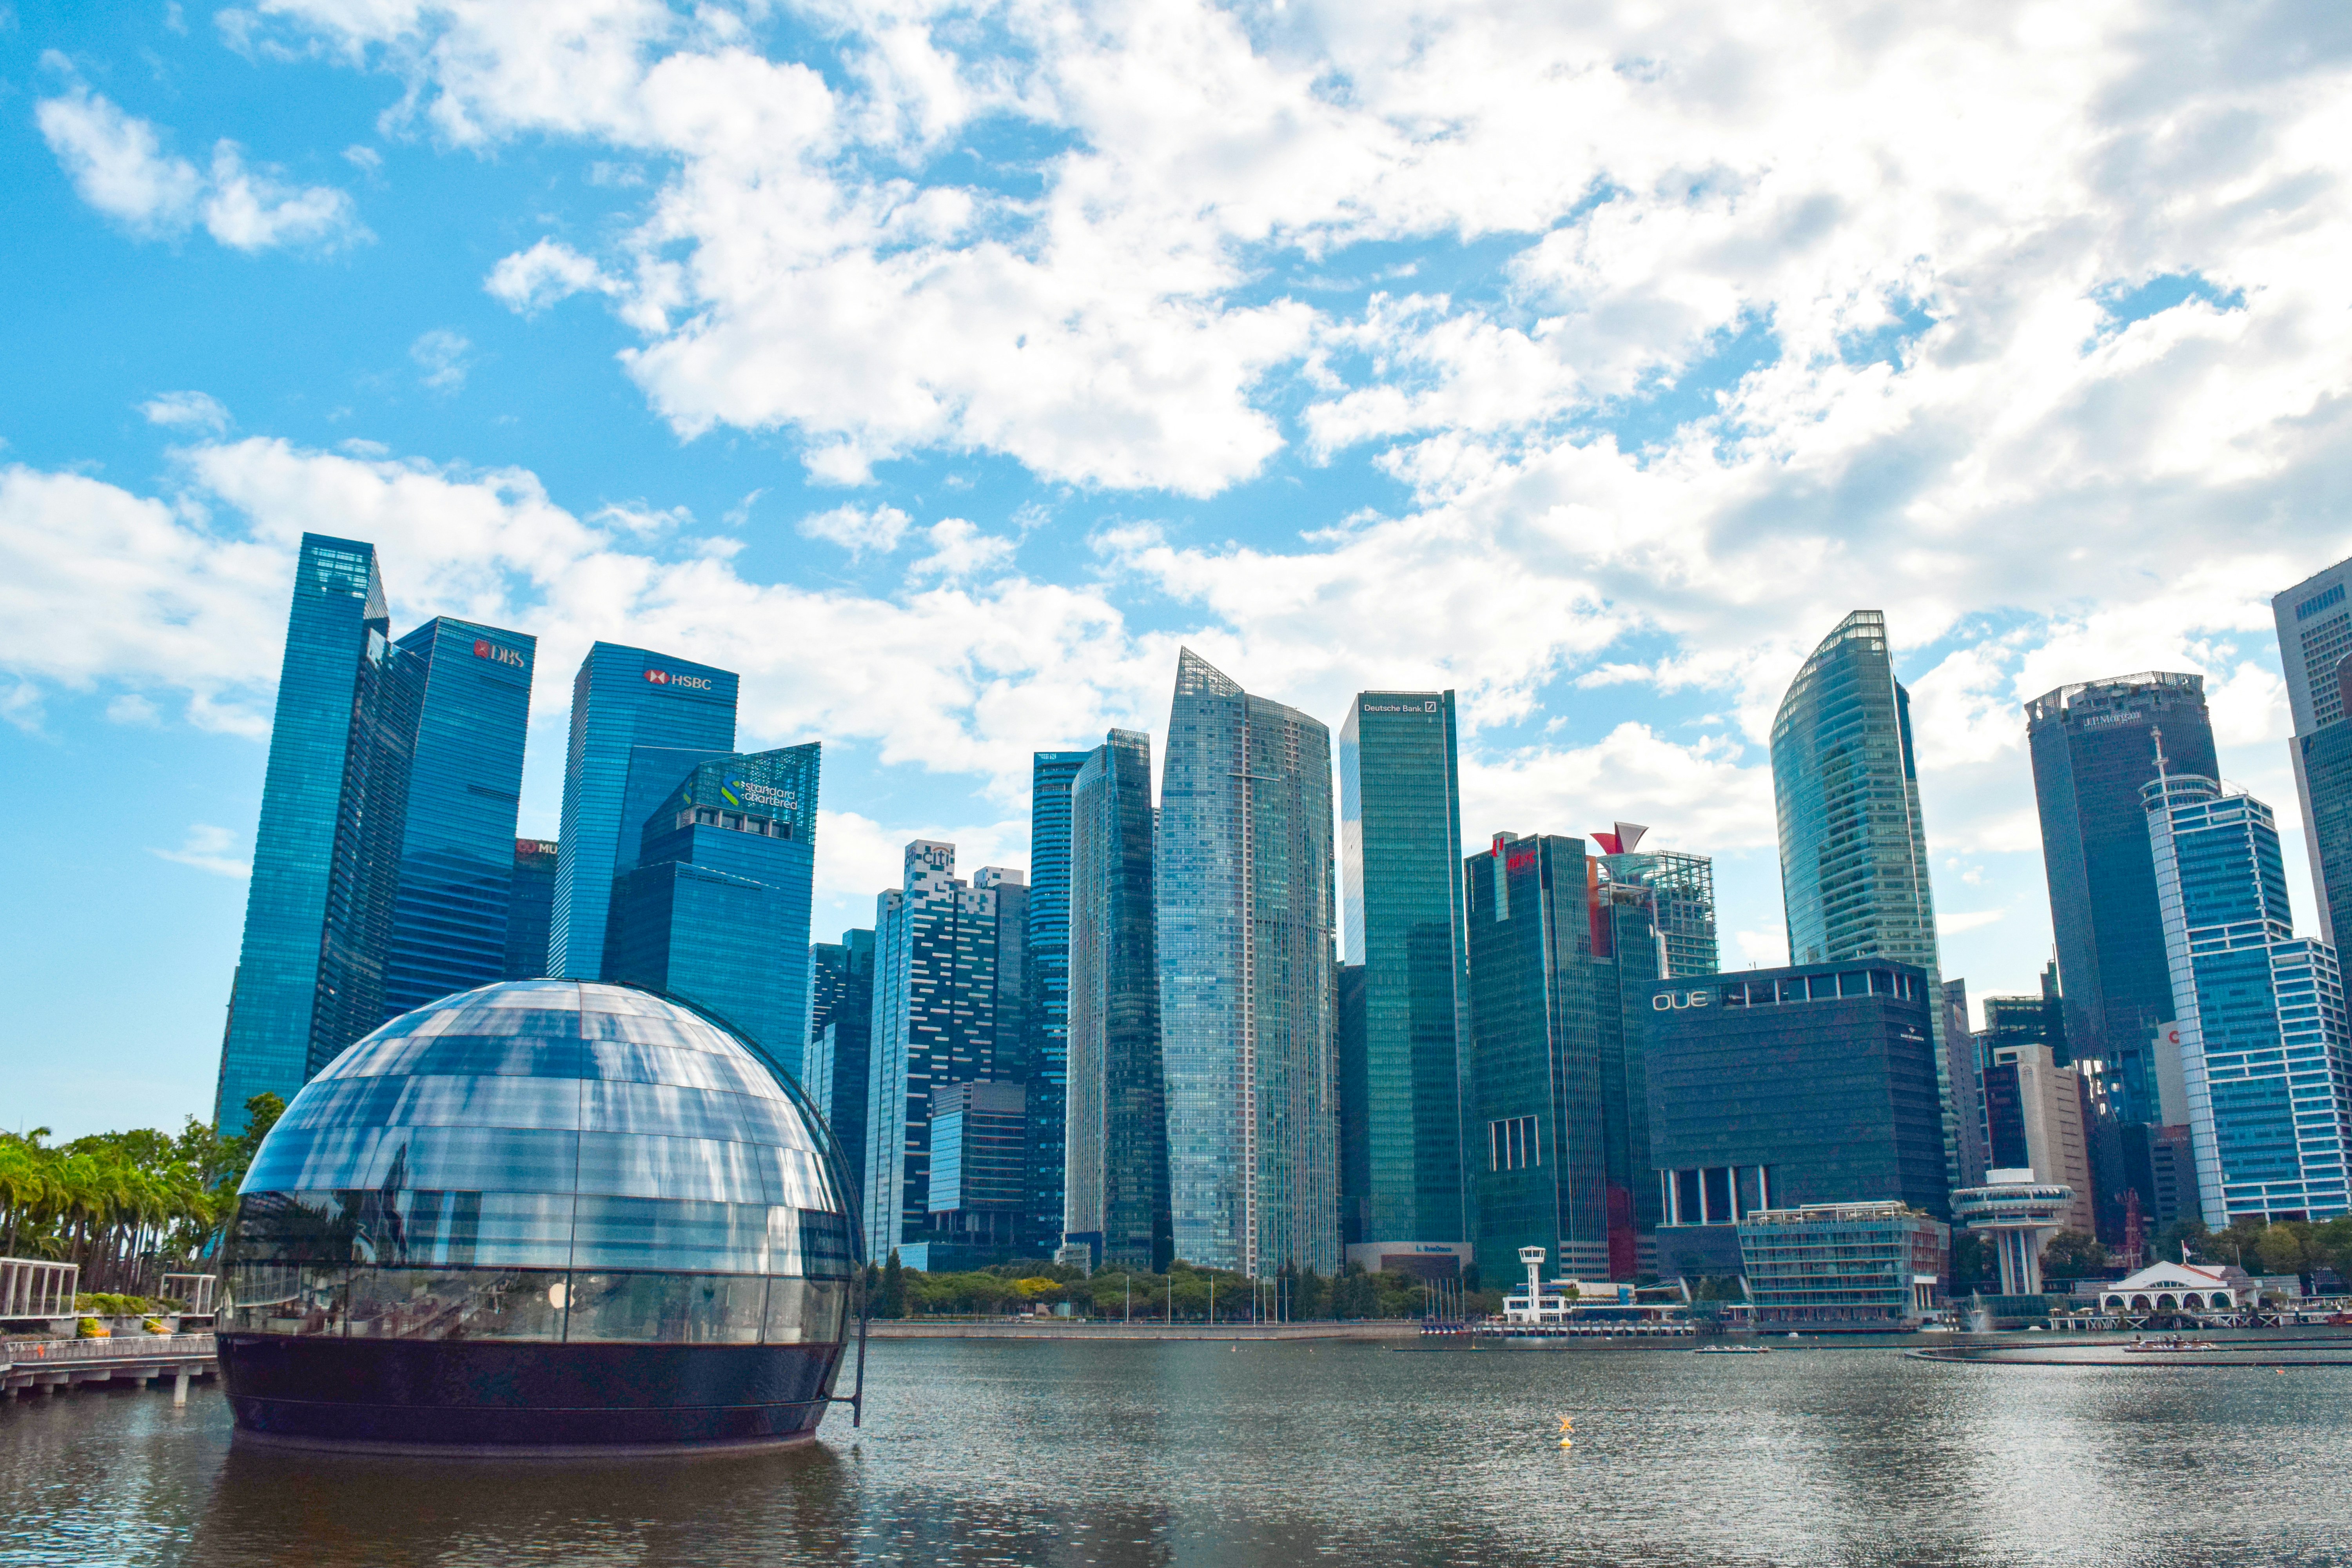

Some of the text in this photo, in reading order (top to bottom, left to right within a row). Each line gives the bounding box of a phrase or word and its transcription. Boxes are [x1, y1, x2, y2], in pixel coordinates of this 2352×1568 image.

[491, 645, 524, 667] DBS
[671, 674, 712, 690] HSBC
[745, 782, 795, 800] standard
[745, 793, 798, 810] chartered
[922, 850, 949, 866] citi
[1653, 991, 1708, 1011] OUE
